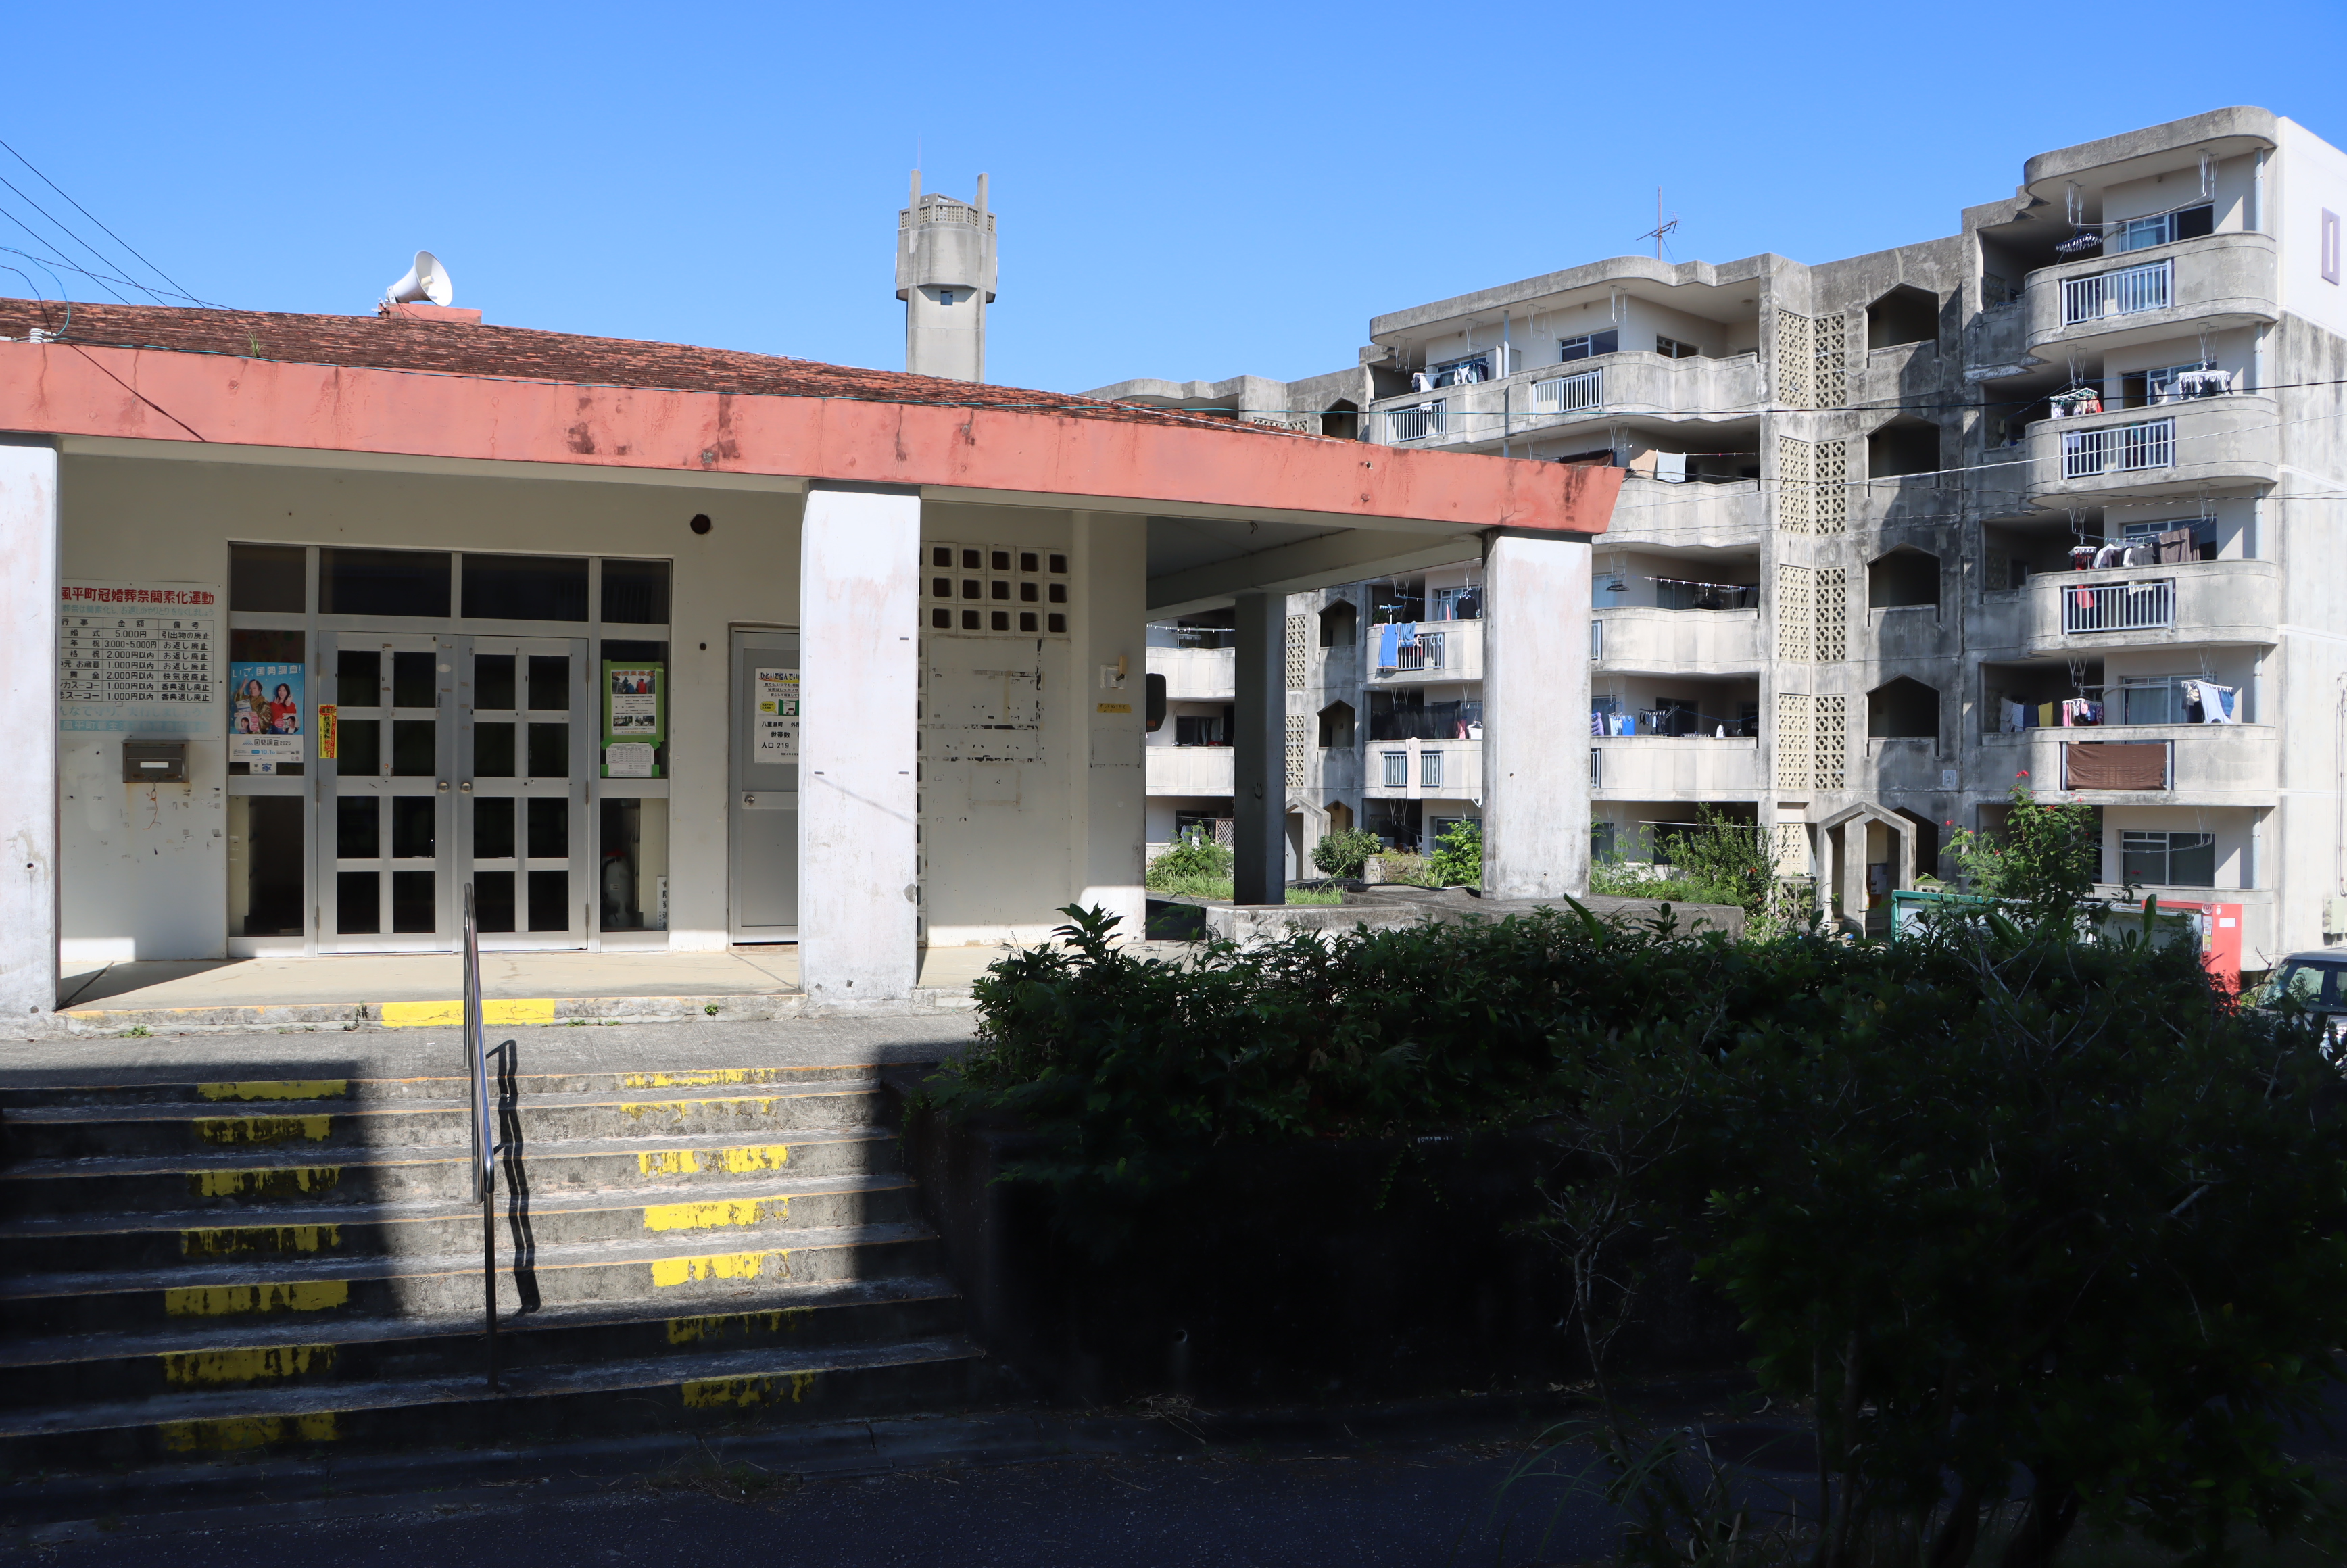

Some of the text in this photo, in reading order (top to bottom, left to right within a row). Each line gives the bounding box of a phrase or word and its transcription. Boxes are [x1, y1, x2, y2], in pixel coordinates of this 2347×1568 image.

[760, 672, 800, 681] ひとりで悩んでい
